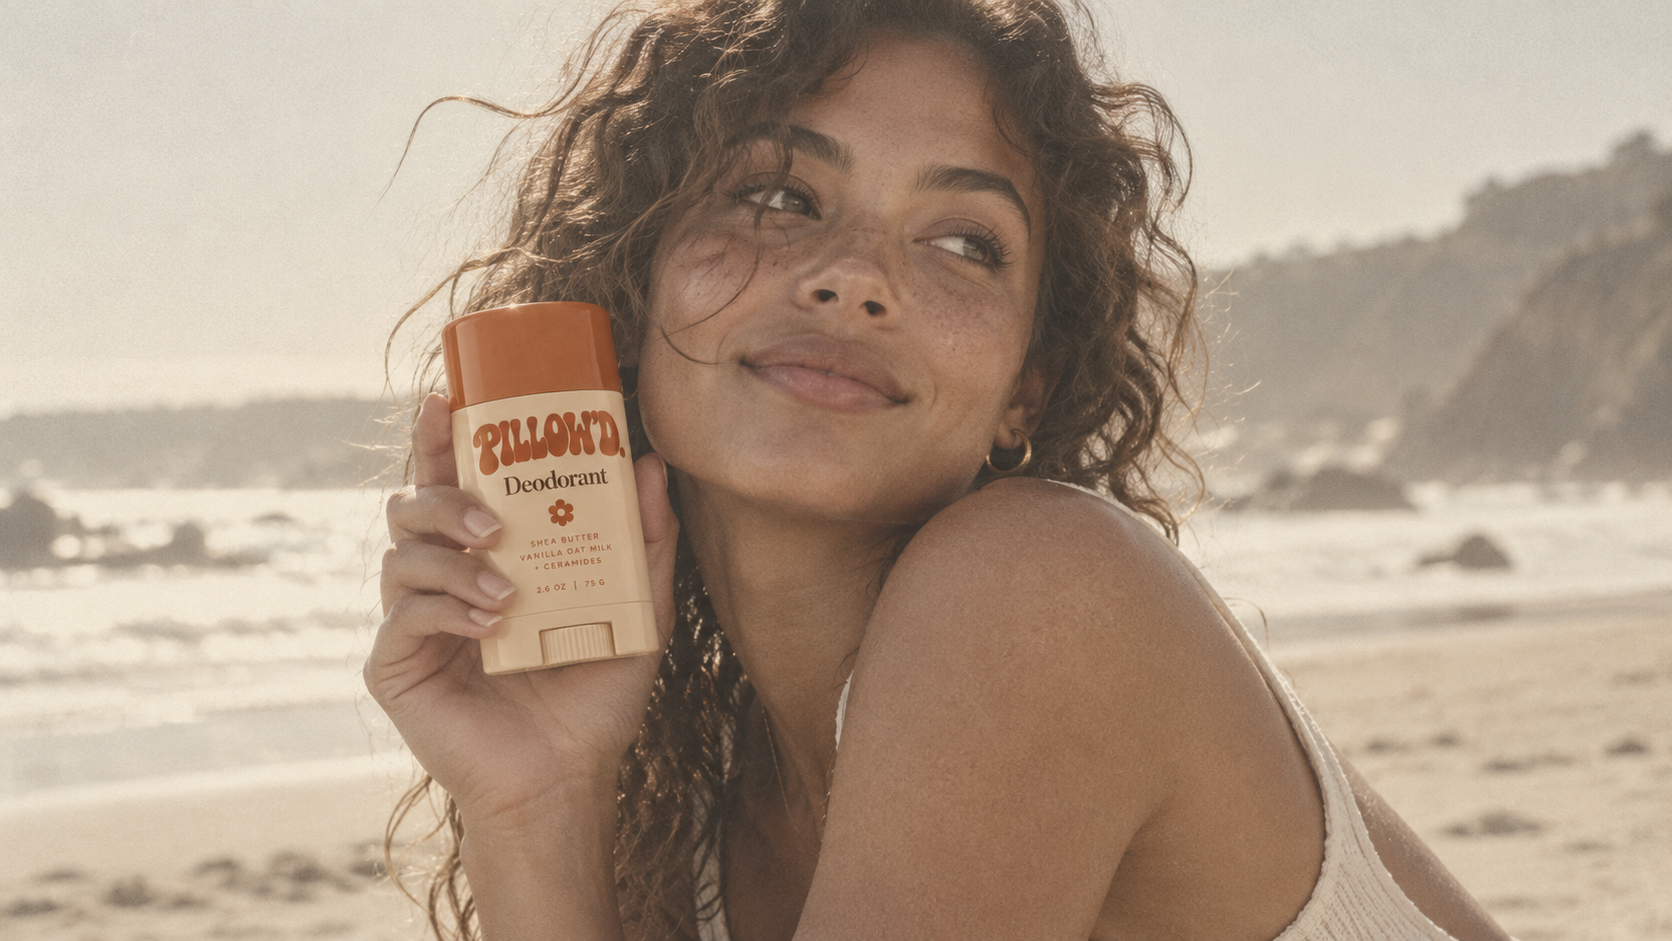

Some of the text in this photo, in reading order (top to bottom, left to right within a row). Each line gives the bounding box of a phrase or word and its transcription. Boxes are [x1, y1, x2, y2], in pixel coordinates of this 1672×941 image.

[503, 468, 608, 496] Deodorant
[530, 532, 599, 548] SHEA BUTTER
[519, 543, 612, 561] VANILLA OAT MILK
[543, 556, 602, 570] CERAMIDES
[536, 585, 550, 594] 2.6
[553, 583, 566, 591] OZ
[598, 578, 605, 586] G
